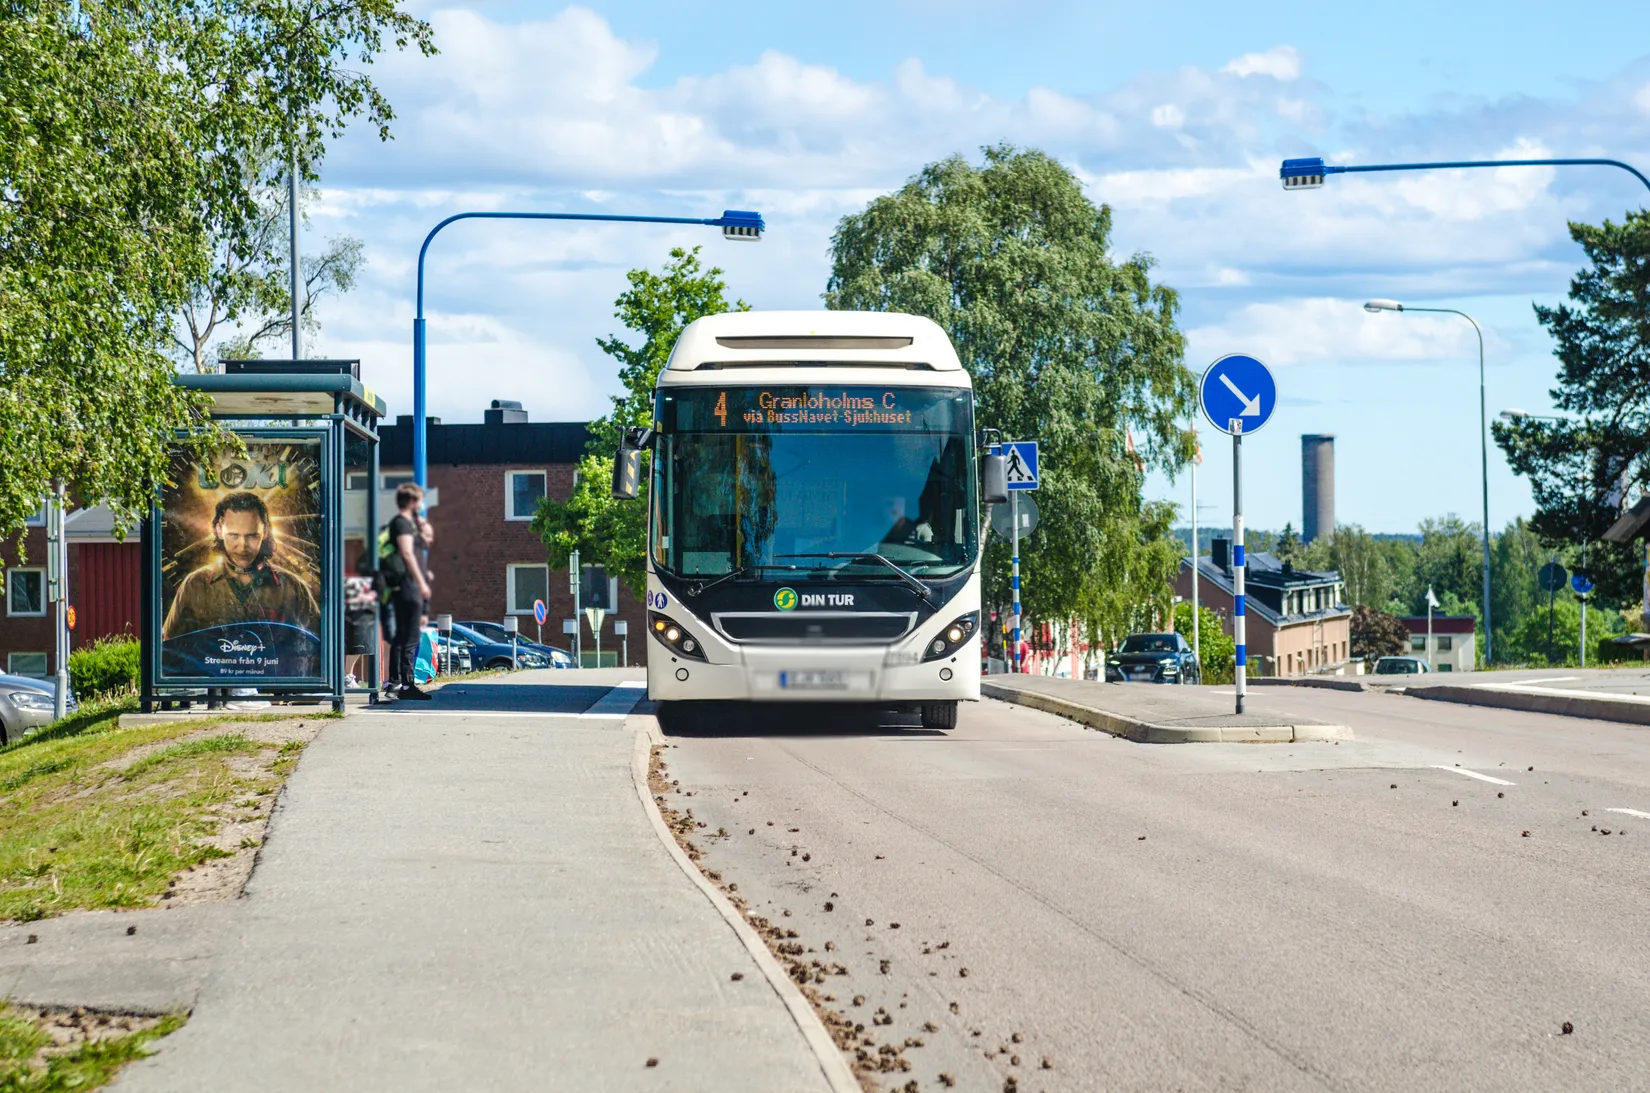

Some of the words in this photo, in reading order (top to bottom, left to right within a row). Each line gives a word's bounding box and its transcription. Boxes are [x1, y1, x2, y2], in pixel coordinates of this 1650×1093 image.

[714, 391, 728, 427] 4
[759, 391, 874, 409] Granloholms
[882, 391, 896, 409] C
[743, 409, 763, 423] via
[198, 462, 289, 490] LOKI
[801, 594, 826, 606] DIN
[827, 594, 854, 606] TUR
[217, 638, 266, 656] Disney+
[204, 656, 237, 664] Streama
[238, 656, 255, 664] från
[263, 657, 279, 667] juni
